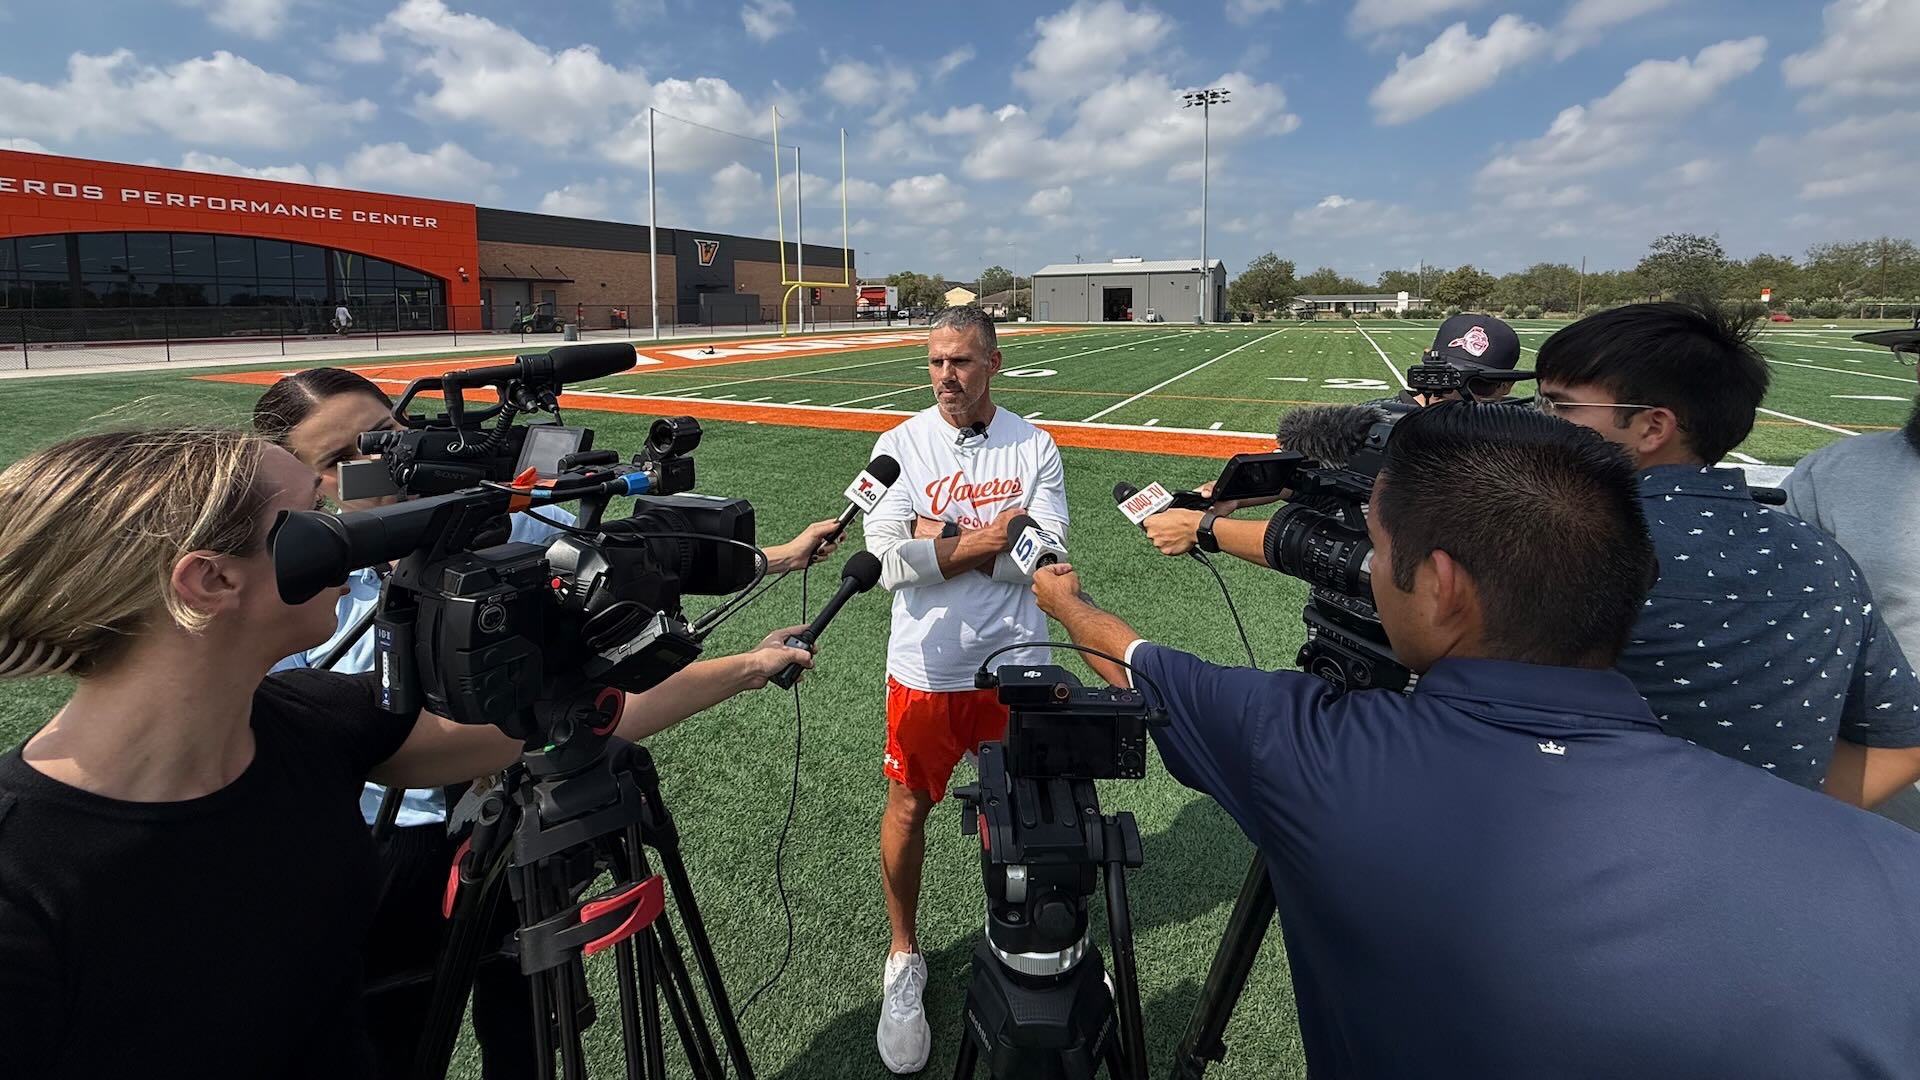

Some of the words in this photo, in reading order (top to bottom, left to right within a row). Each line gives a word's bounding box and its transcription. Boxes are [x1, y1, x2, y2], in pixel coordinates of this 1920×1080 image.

[121, 188, 343, 220] PERFORMANCE
[352, 211, 438, 229] CENTER
[864, 490, 877, 501] 40
[1016, 534, 1033, 561] 5
